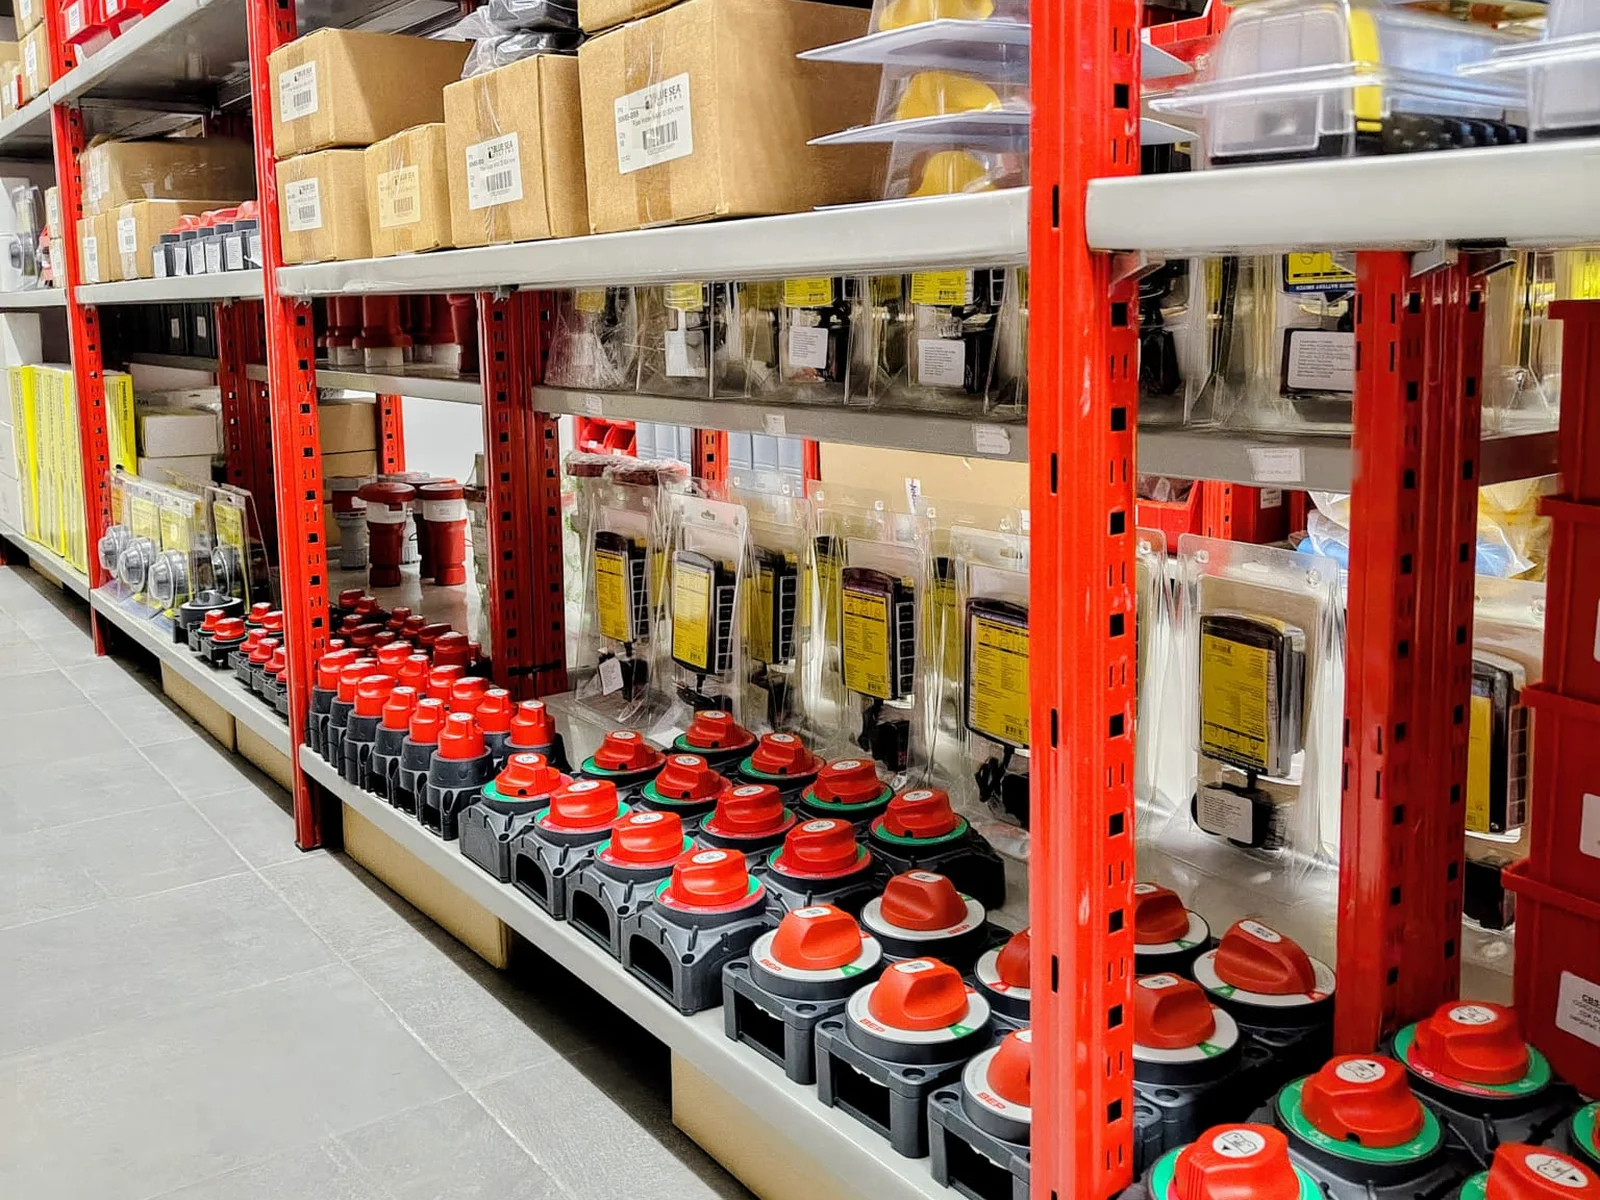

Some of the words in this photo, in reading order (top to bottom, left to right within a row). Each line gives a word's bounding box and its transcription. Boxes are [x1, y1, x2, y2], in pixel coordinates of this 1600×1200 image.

[668, 84, 681, 96] SEA
[760, 959, 782, 972] BEP
[859, 1018, 886, 1033] BEP
[976, 1092, 1007, 1109] BEP
